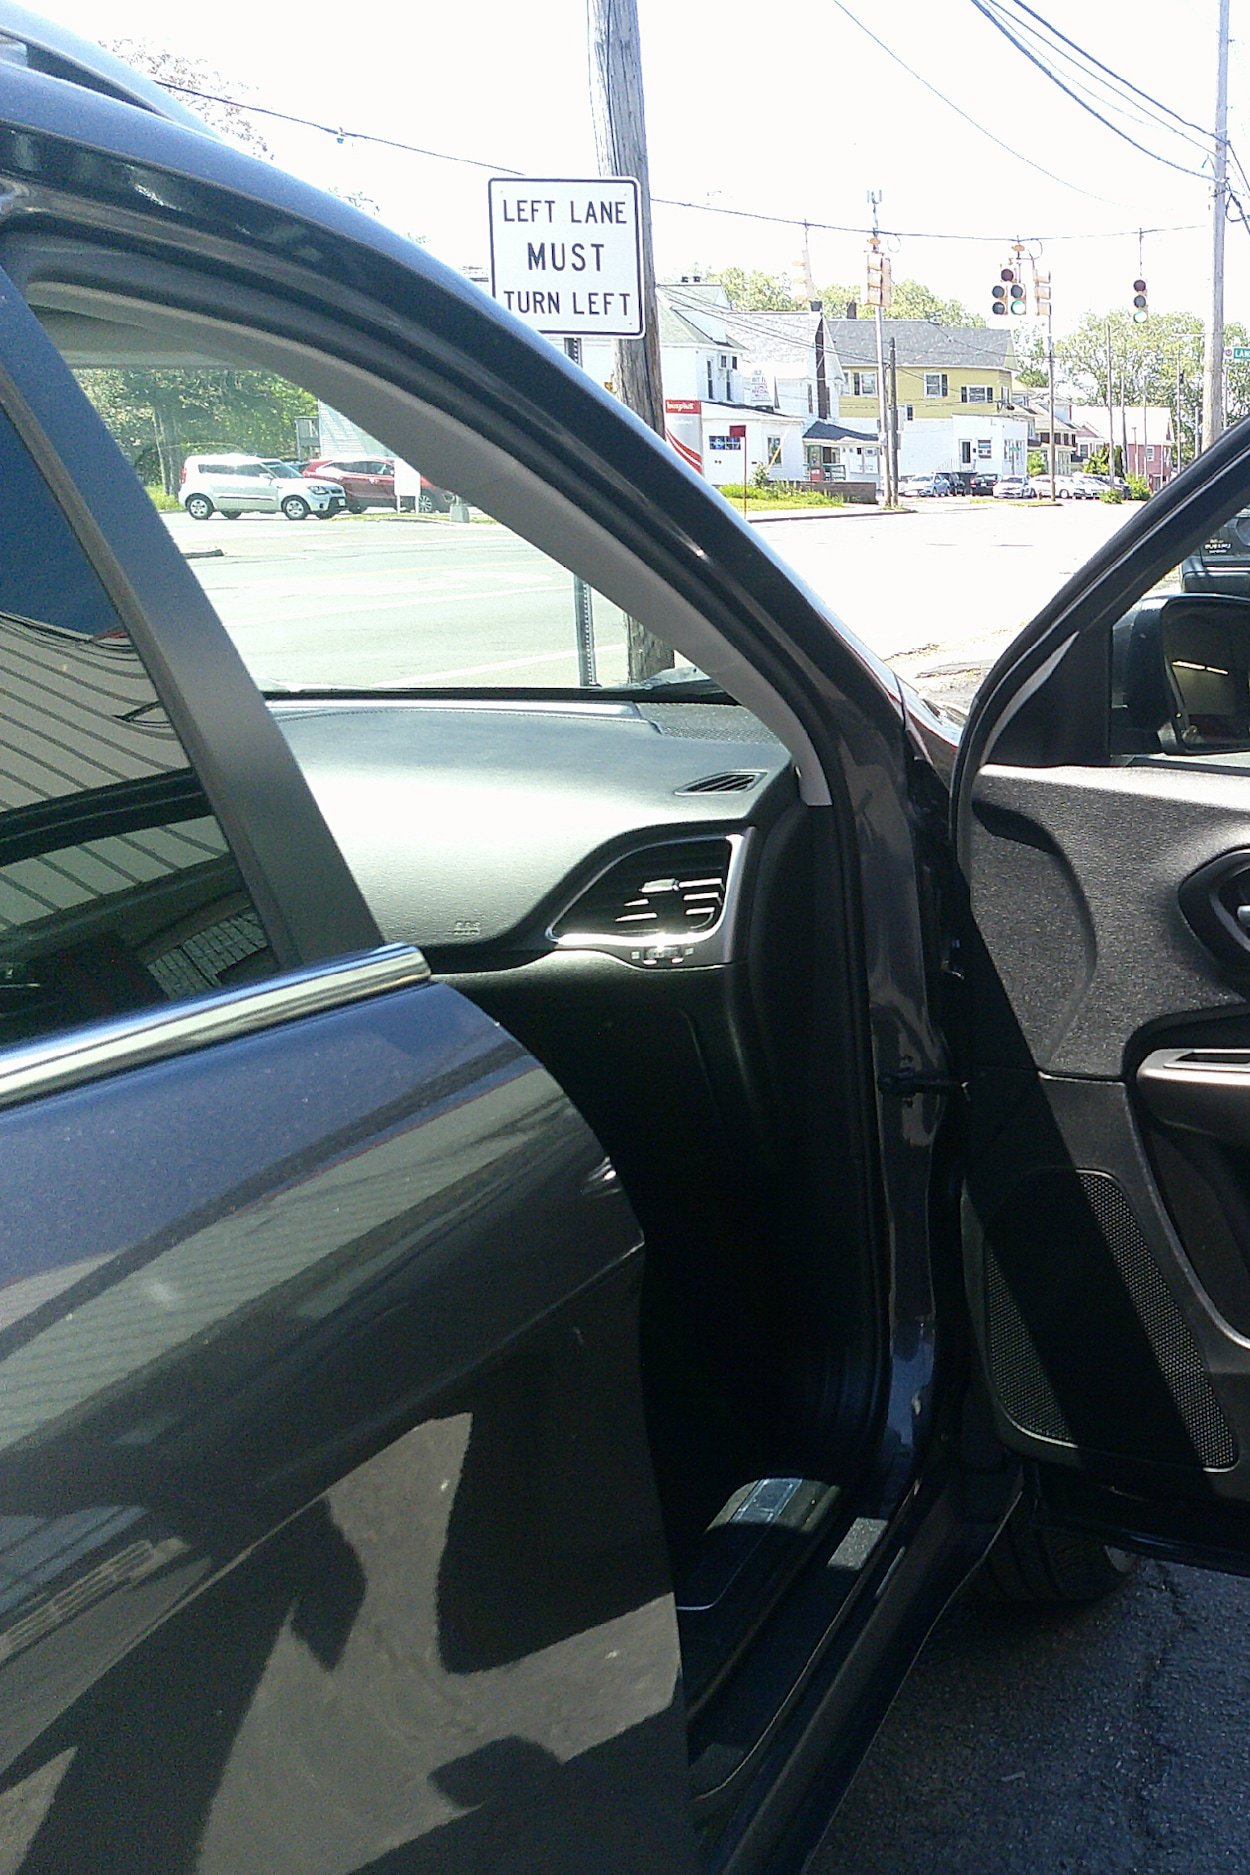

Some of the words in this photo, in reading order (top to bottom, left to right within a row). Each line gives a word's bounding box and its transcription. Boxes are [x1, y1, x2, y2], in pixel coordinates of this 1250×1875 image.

[503, 199, 555, 223] LEFT
[570, 200, 627, 224] LANE
[527, 242, 604, 272] MUST
[503, 290, 560, 314] TURN
[572, 291, 631, 316] LEFT
